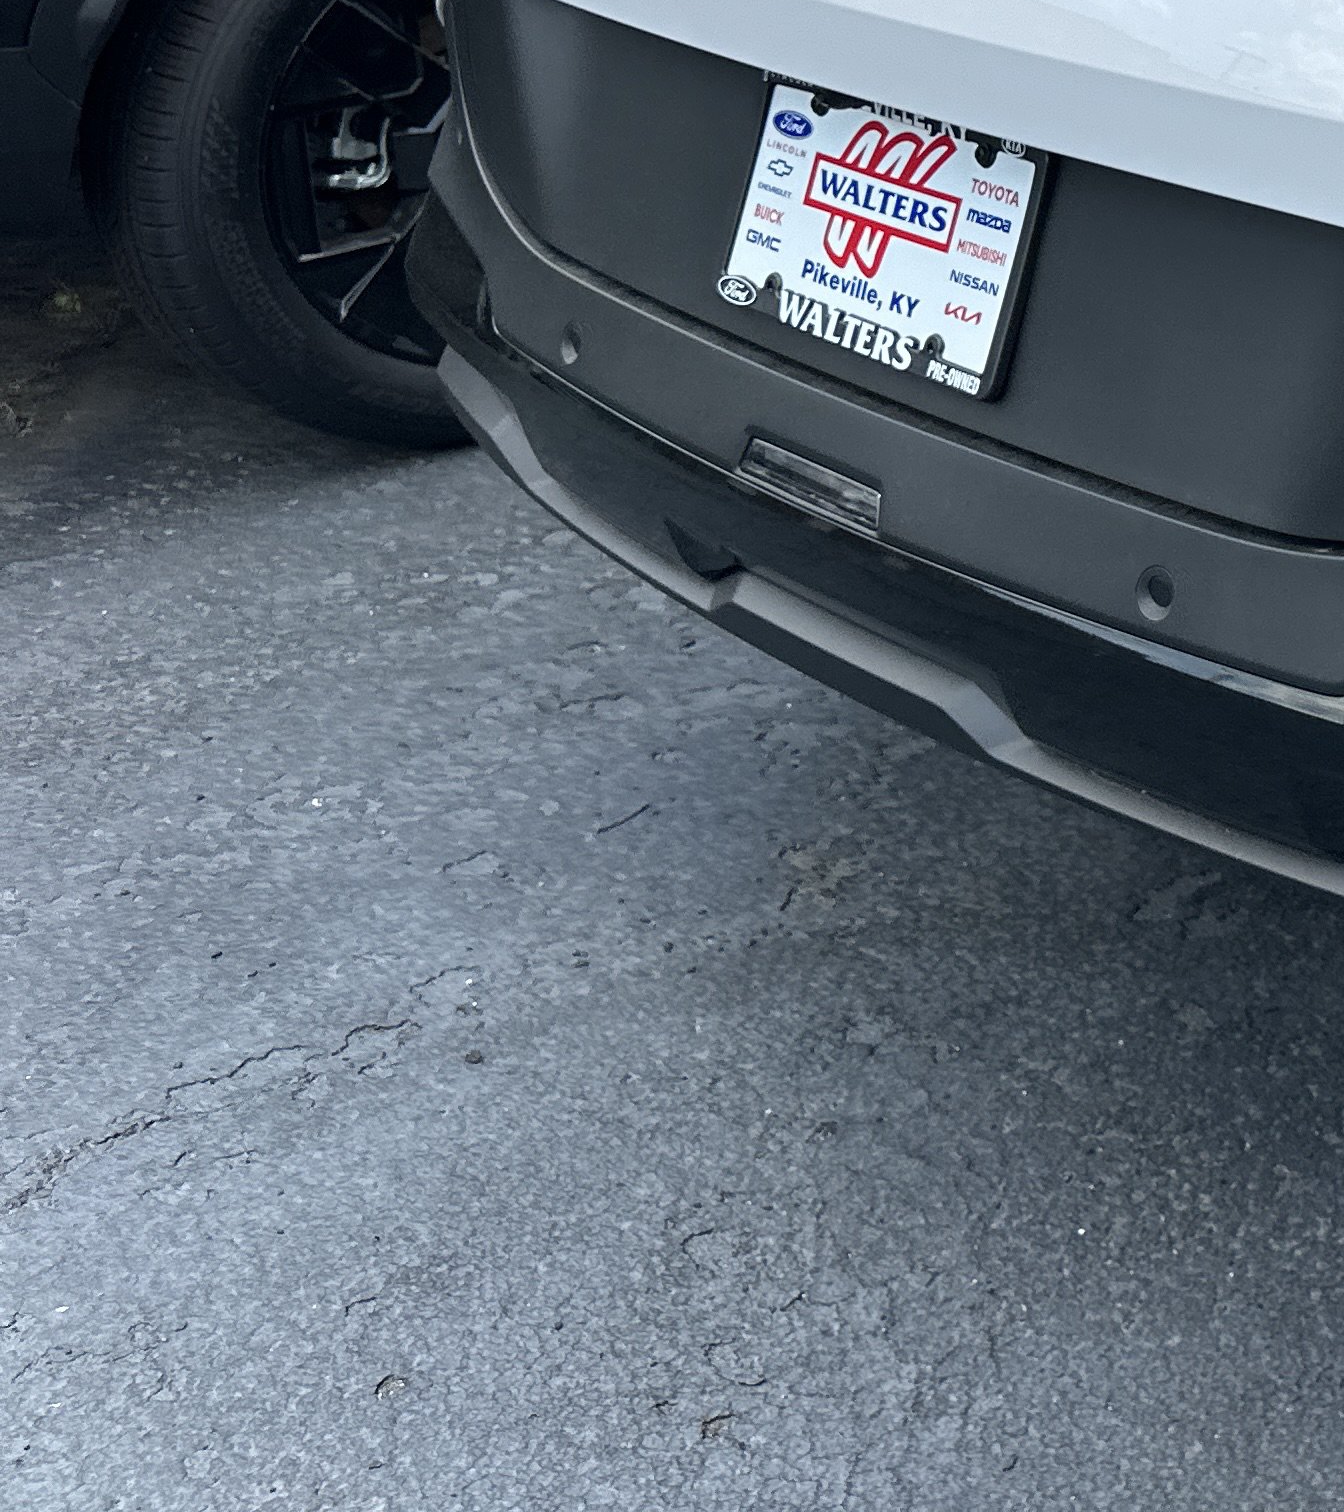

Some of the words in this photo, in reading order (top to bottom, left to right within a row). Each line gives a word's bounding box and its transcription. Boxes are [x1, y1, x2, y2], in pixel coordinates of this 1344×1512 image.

[779, 112, 806, 135] Ford
[766, 138, 807, 158] LINCOLN
[820, 169, 948, 232] WALTERS
[971, 178, 1020, 208] TOYOTA
[753, 203, 785, 226] BUICK
[746, 228, 782, 253] GMC
[956, 238, 1008, 267] MITSUBISHI
[801, 258, 882, 311] Pikeville,
[889, 291, 920, 318] KY
[949, 268, 1000, 297] NISSAN
[944, 302, 983, 326] KIA
[778, 290, 914, 371] WALTERS
[926, 359, 981, 396] PRE-OWNED
